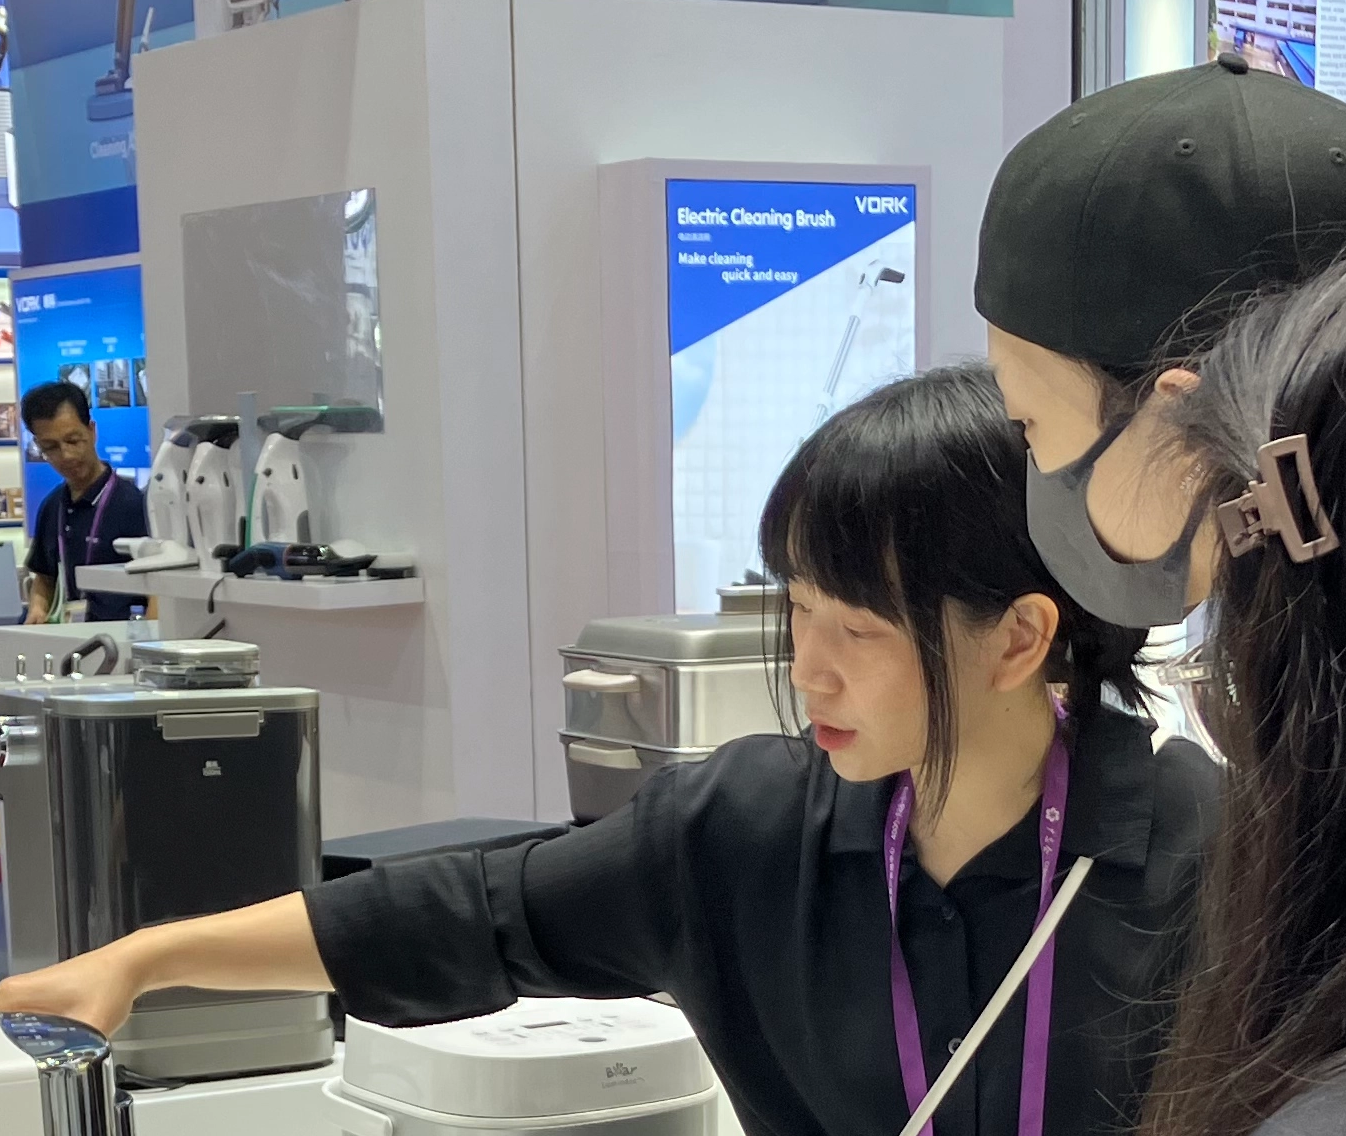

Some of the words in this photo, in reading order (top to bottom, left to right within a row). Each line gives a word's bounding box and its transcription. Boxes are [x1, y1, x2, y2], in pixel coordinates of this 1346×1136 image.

[854, 195, 909, 214] VORK
[677, 207, 728, 226] Electric
[730, 208, 793, 231] Cleaning
[795, 209, 836, 228] Brush
[678, 252, 707, 265] Make
[708, 251, 754, 267] cleaning
[721, 268, 752, 284] quick
[753, 269, 773, 282] and
[774, 271, 799, 285] easy
